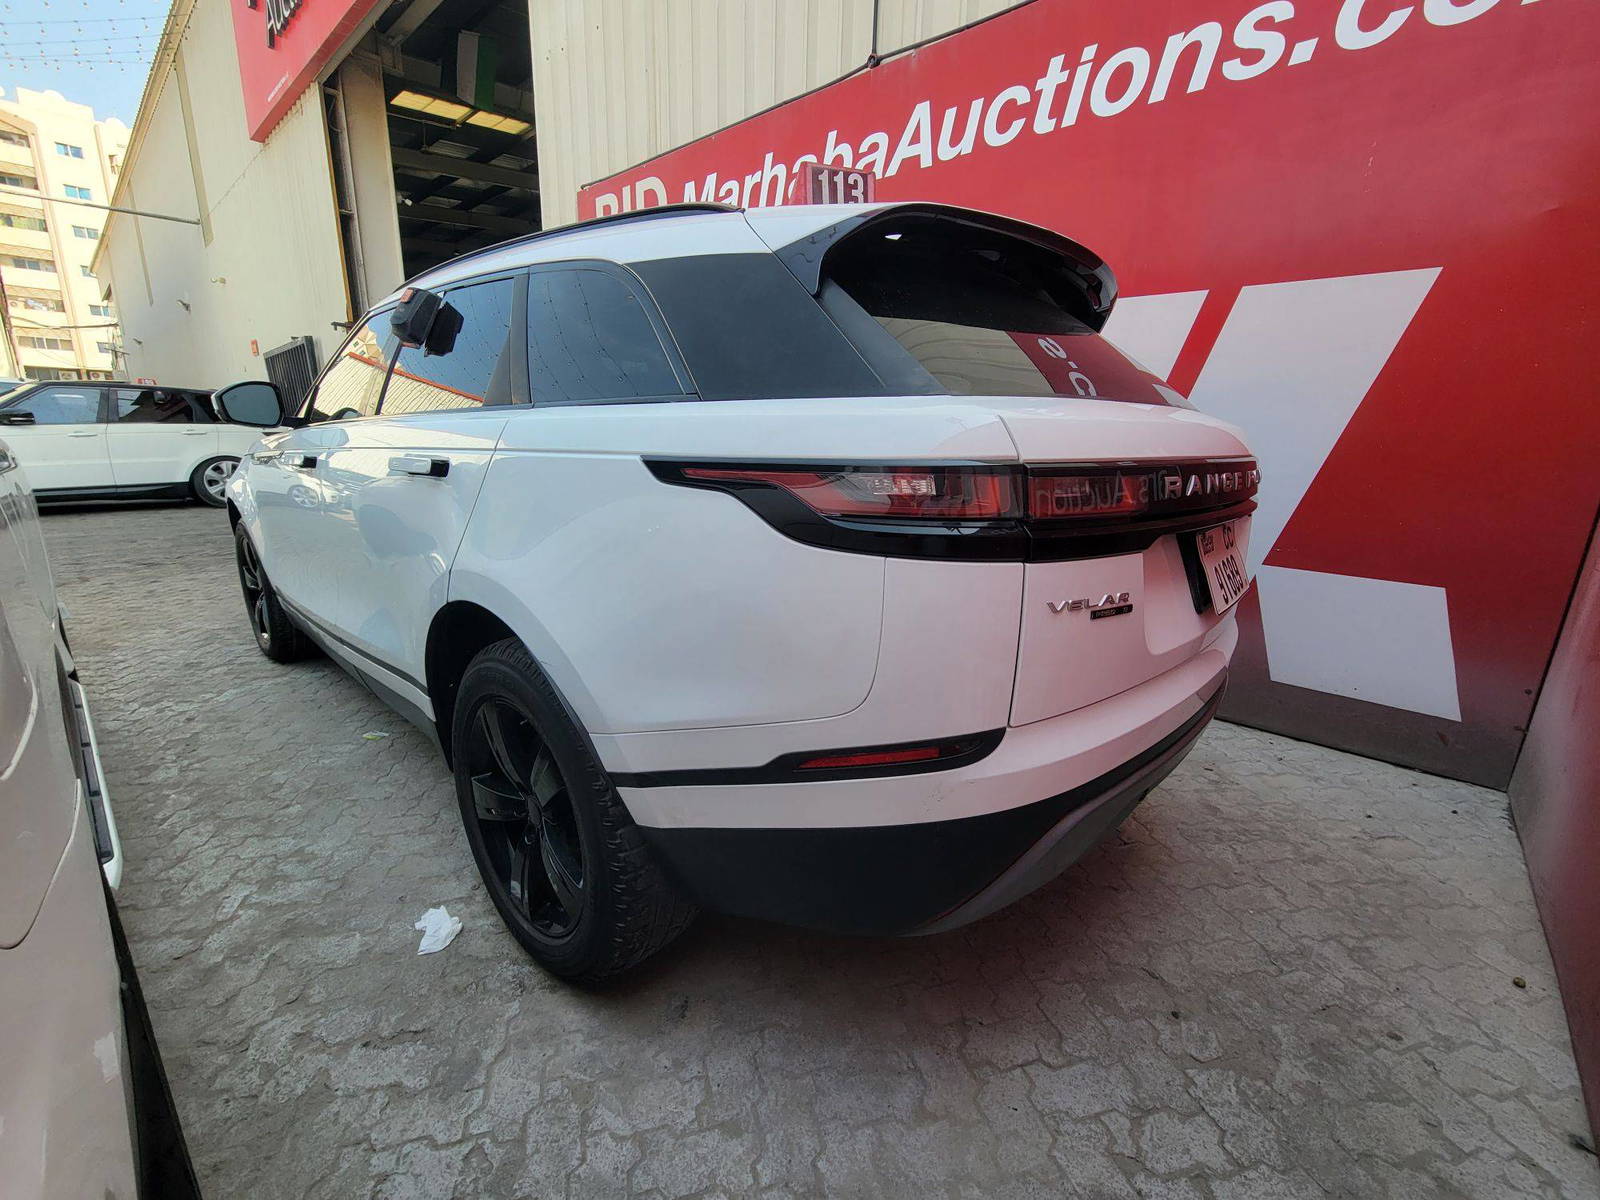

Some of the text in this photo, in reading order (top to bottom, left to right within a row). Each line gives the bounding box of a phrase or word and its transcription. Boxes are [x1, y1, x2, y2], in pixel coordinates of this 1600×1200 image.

[682, 0, 1546, 208] MarhbaAuctions.c
[1164, 472, 1243, 499] RANGE
[1046, 592, 1131, 614] VELAR
